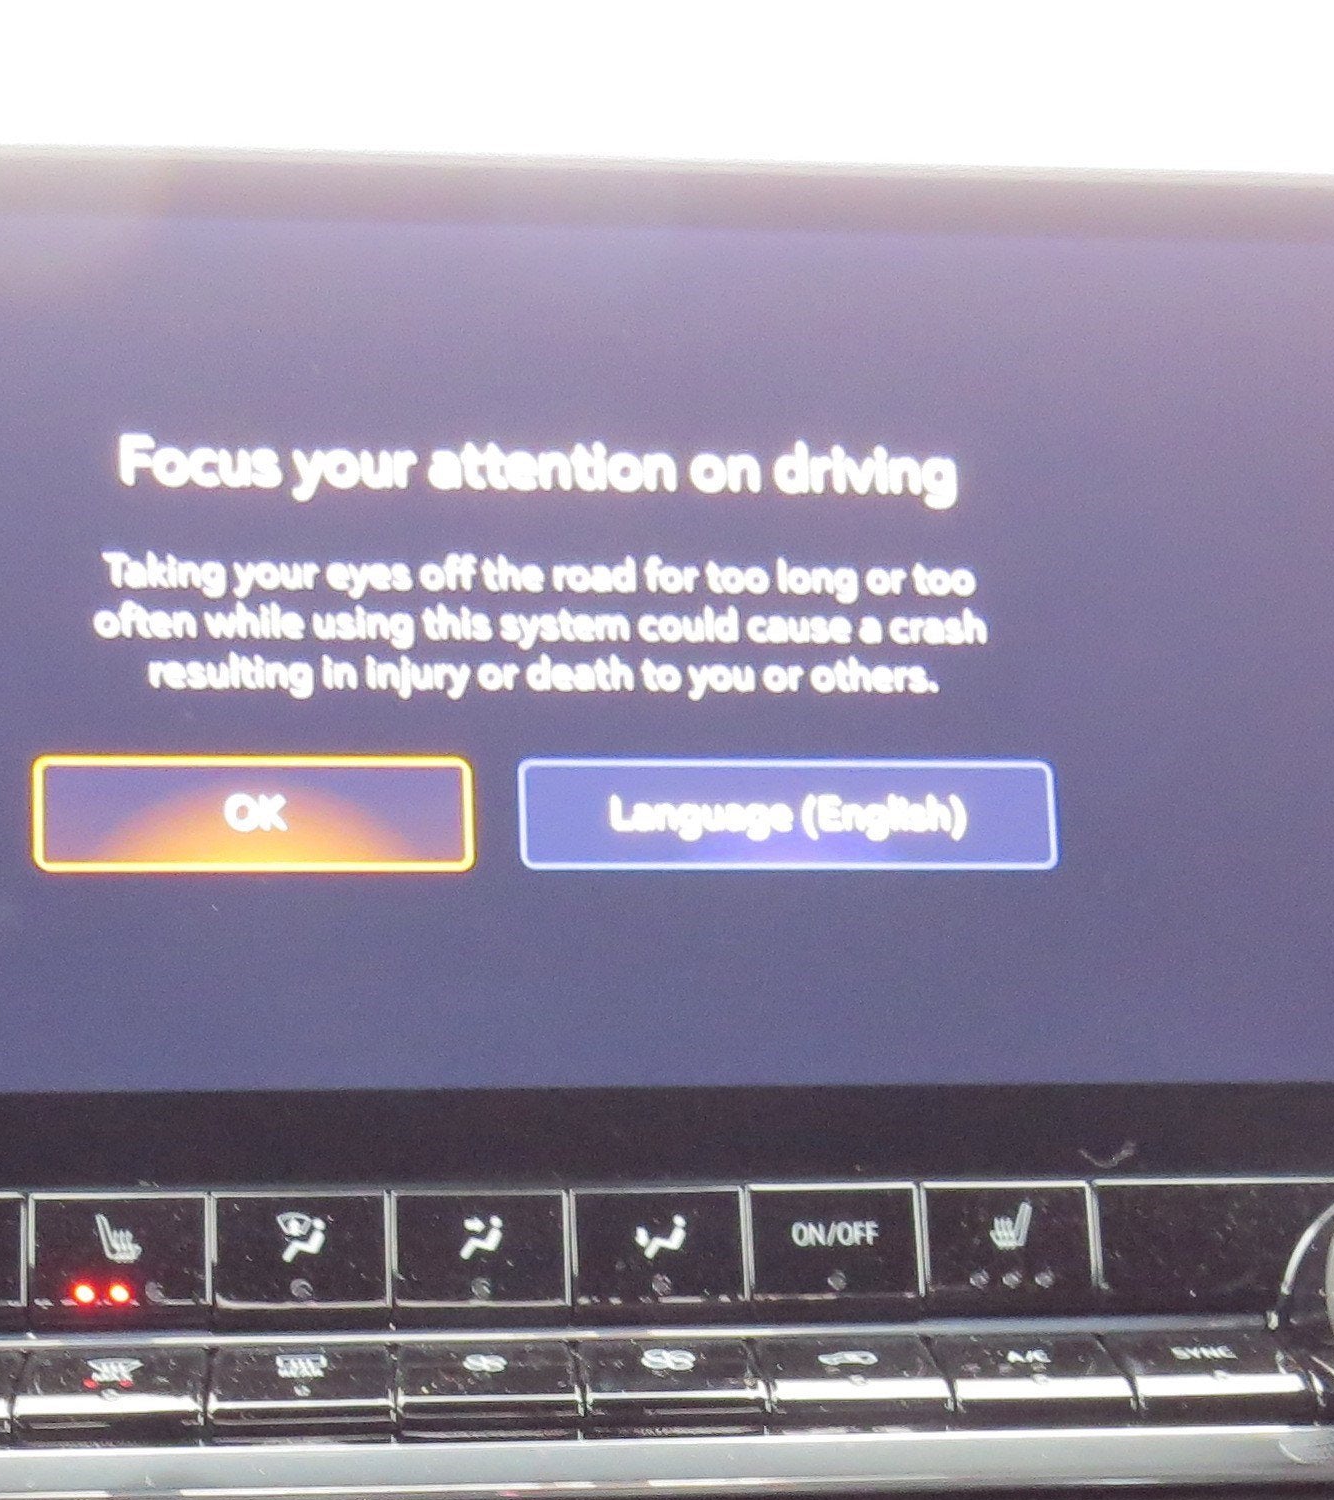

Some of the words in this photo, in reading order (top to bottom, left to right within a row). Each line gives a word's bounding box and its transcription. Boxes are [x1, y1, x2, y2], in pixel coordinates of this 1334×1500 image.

[118, 432, 283, 489] Focus
[291, 448, 418, 502] your
[427, 440, 678, 493] attention
[689, 452, 762, 494] on
[773, 440, 958, 510] driving
[102, 550, 227, 597] Taking
[233, 563, 319, 602] your
[326, 565, 413, 602] eyes
[419, 552, 476, 592] off
[479, 555, 546, 593] the
[552, 555, 637, 594] road
[643, 554, 700, 594] for
[705, 560, 771, 595] too
[776, 557, 859, 605] long
[865, 566, 909, 598] or
[913, 562, 977, 598] too
[93, 598, 198, 639] often
[203, 602, 306, 640] while
[312, 605, 415, 650] using
[421, 602, 493, 642] this
[499, 609, 631, 651] system
[637, 604, 740, 643] could
[746, 615, 852, 645] cause
[857, 616, 883, 645] a
[889, 607, 988, 646] crash
[148, 651, 314, 699] resulting
[321, 654, 358, 690] in
[365, 655, 471, 700] injury
[477, 660, 520, 691] or
[524, 652, 635, 693] death
[640, 657, 681, 693] to
[684, 664, 756, 701] you
[762, 664, 805, 693] or
[810, 655, 940, 694] others.
[223, 792, 288, 832] OK
[608, 793, 795, 842] Language
[800, 793, 968, 843] (English)
[790, 1220, 880, 1248] ON/OFF
